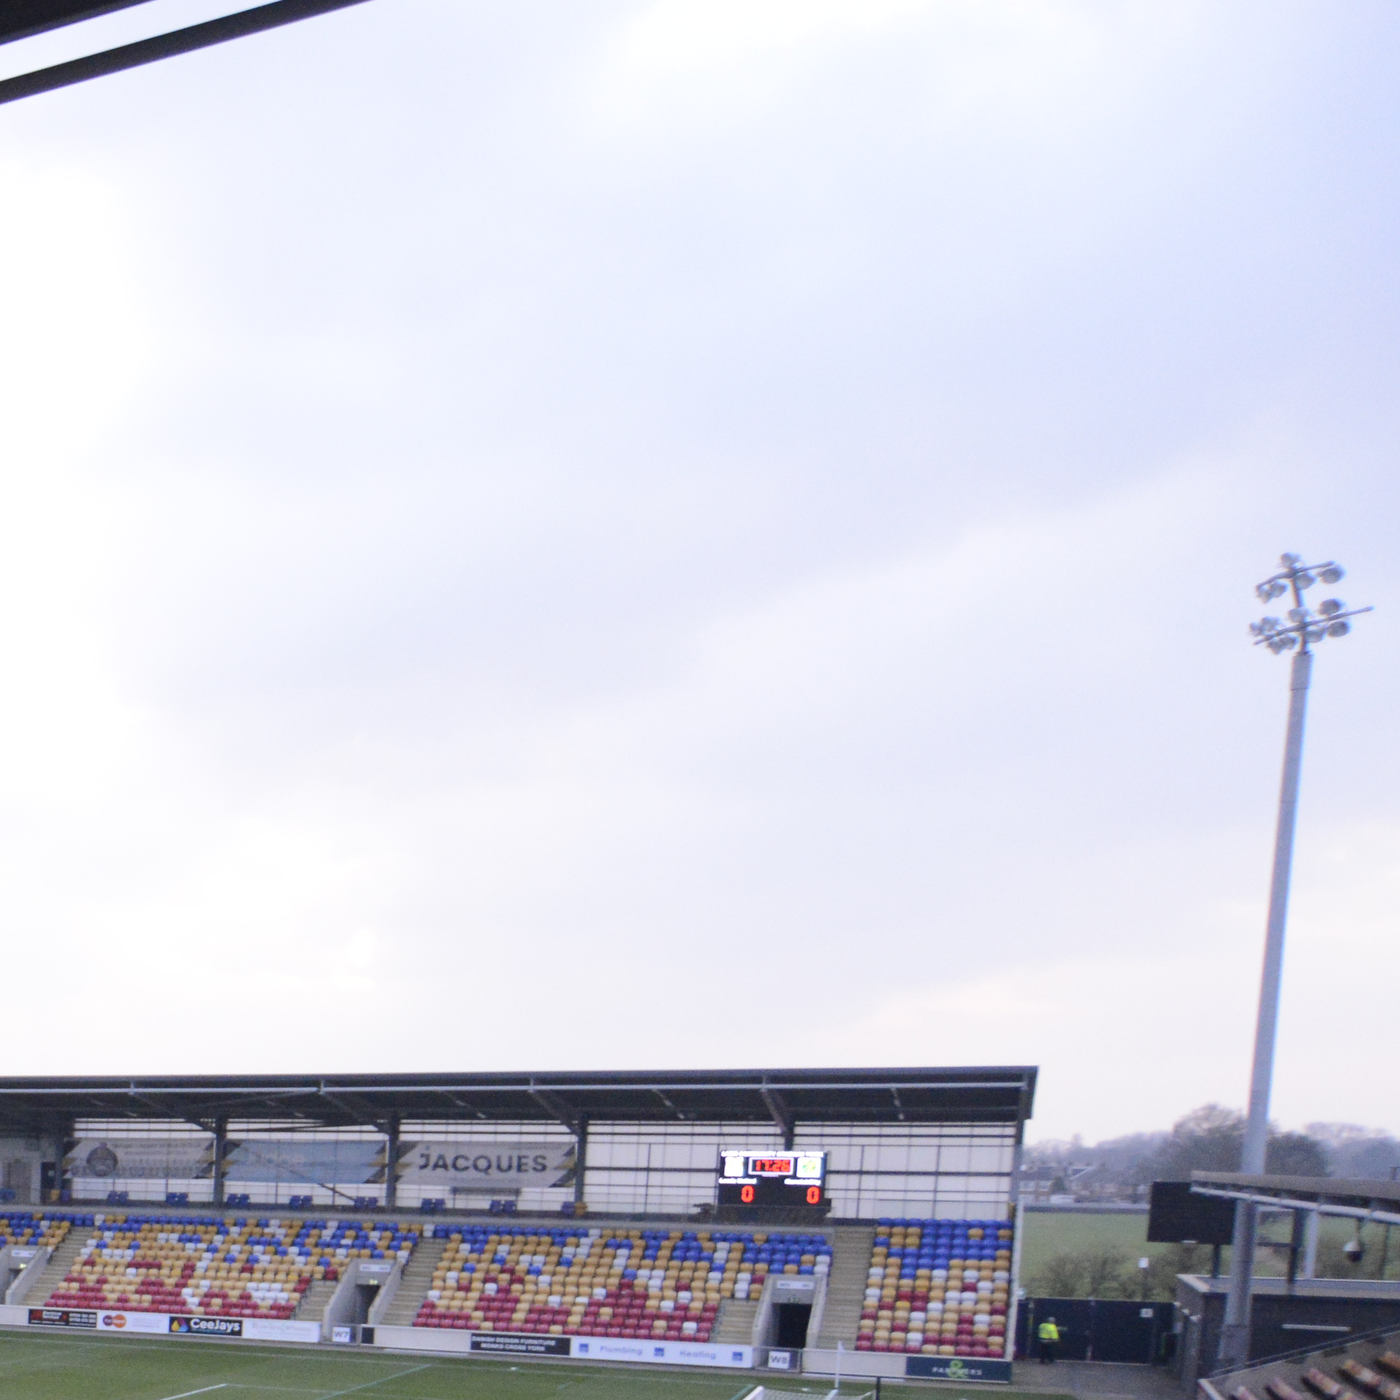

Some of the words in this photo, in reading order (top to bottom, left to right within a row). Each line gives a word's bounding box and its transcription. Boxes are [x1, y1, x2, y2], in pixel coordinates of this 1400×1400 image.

[418, 1153, 548, 1175] JACQUES
[741, 1185, 754, 1203] 0
[806, 1186, 820, 1204] 0
[190, 1318, 241, 1333] CeeJays
[334, 1331, 350, 1339] W7
[520, 1338, 556, 1346] FURNITURE
[600, 1345, 643, 1356] Plumbing
[680, 1350, 716, 1360] Heating
